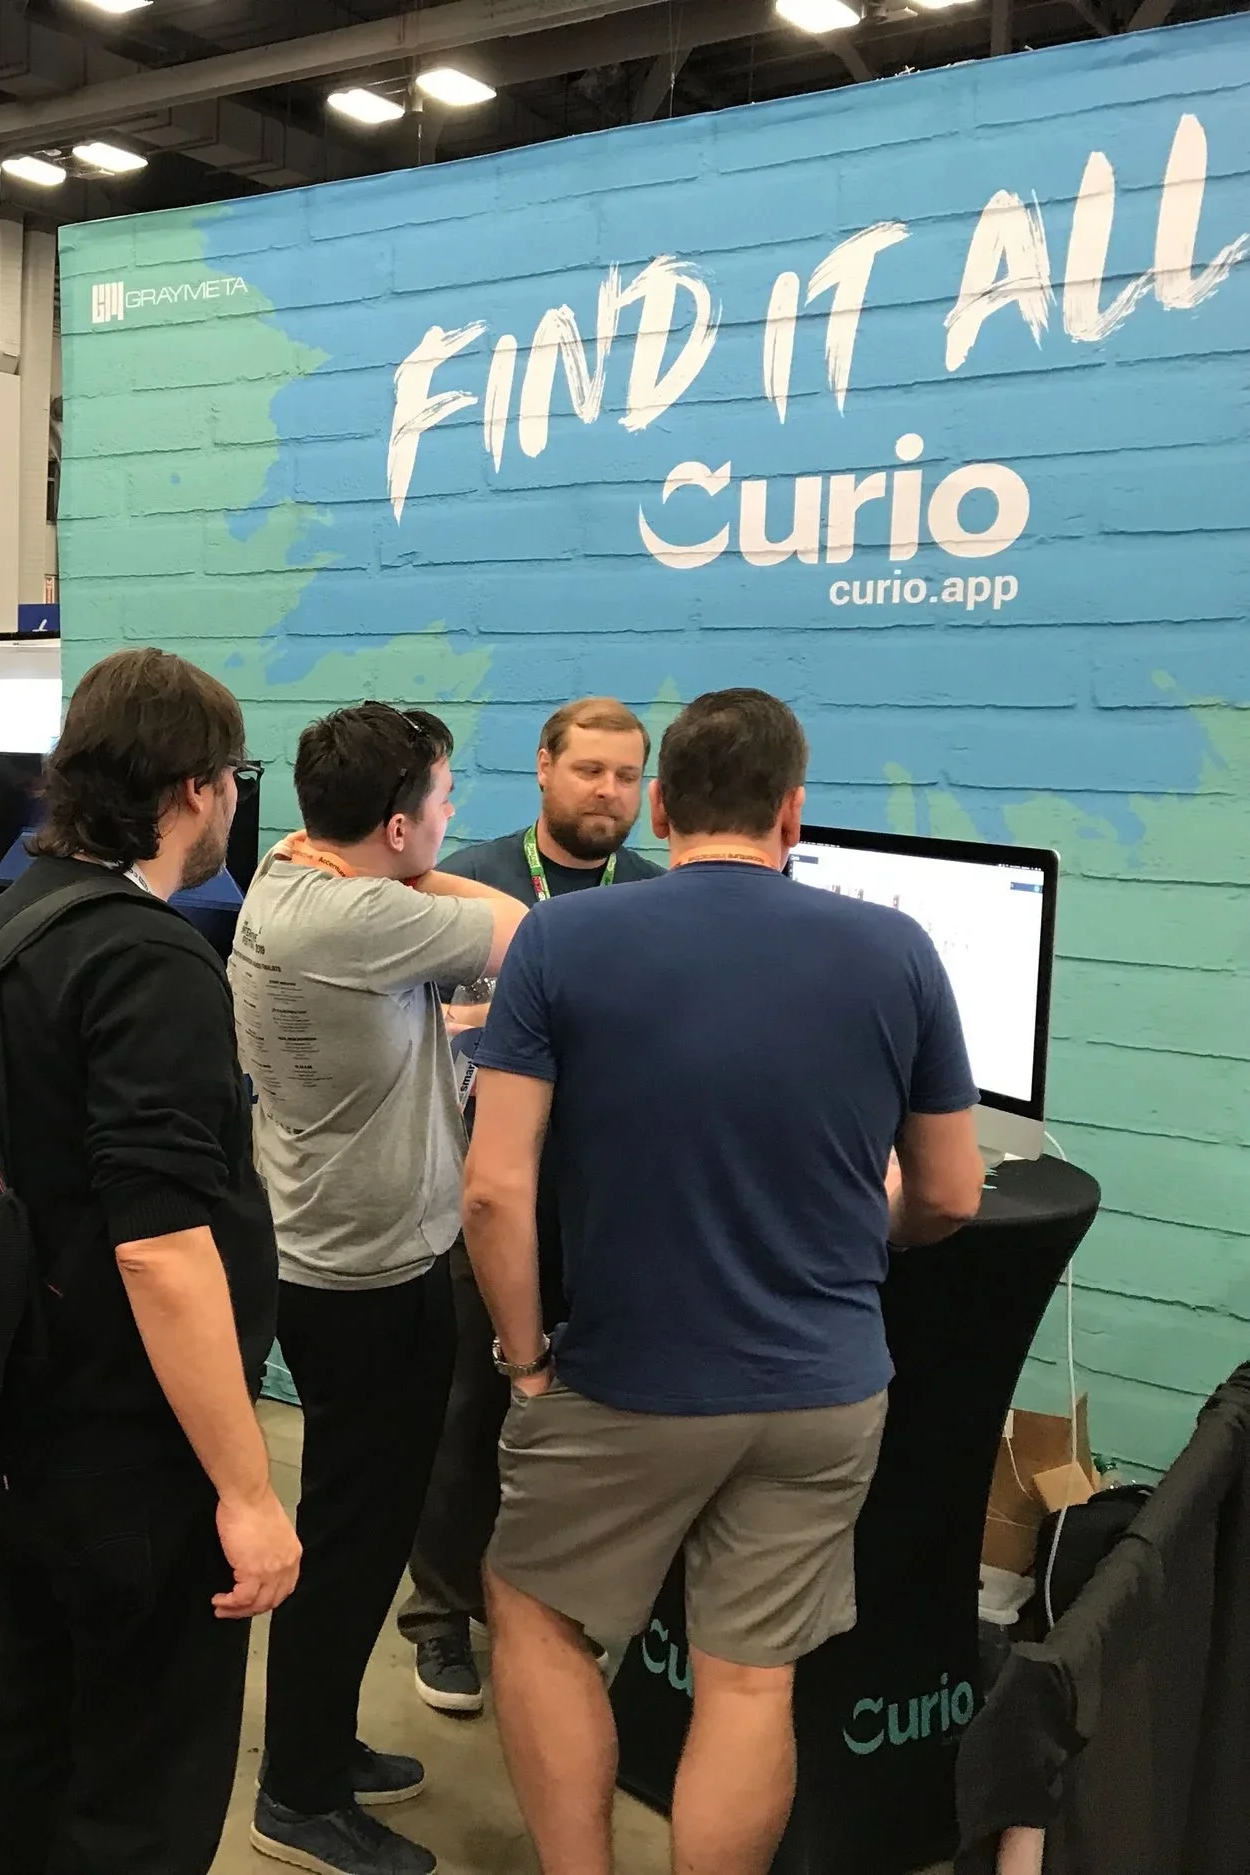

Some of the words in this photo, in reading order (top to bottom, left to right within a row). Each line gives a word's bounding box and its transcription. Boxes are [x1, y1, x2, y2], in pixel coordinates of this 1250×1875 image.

[125, 276, 249, 309] GRAYMETA
[386, 255, 724, 525] FIND
[762, 220, 913, 424] IT
[943, 112, 1250, 372] ALL
[638, 432, 1031, 569] Curio
[829, 570, 1019, 611] curio.app
[642, 1618, 694, 1698] Cu
[842, 1672, 974, 1755] Curio
